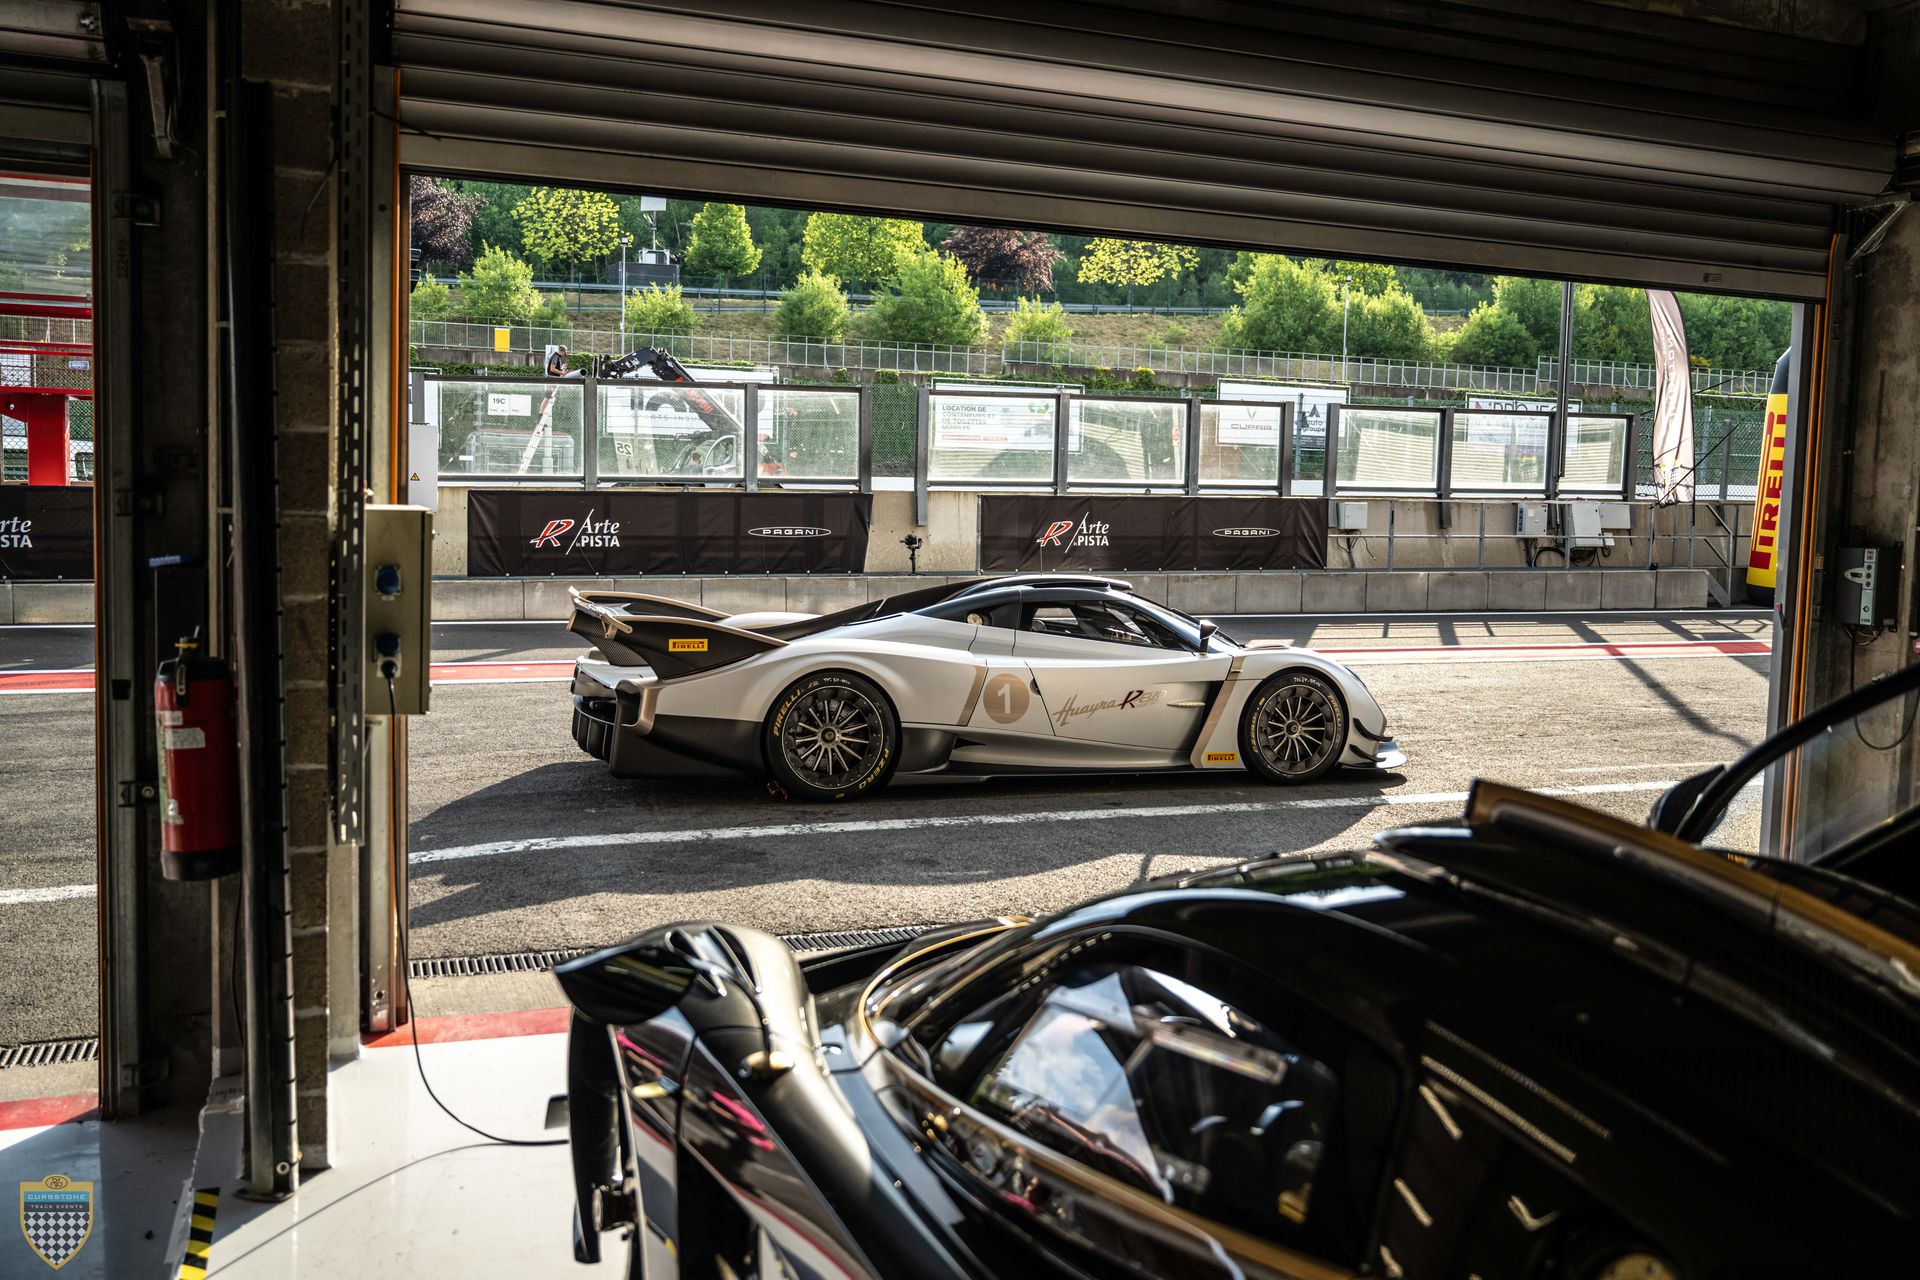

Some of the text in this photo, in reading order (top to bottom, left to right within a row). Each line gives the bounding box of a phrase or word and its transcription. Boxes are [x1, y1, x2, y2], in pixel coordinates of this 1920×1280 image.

[942, 405, 976, 413] LOCATION
[1231, 423, 1272, 431] CUPRA
[0, 516, 32, 533] rte
[581, 517, 620, 534] Arte
[1079, 518, 1110, 534] Arte
[0, 535, 33, 548] STA
[581, 536, 620, 547] PISTA
[1077, 536, 1109, 546] PISTA
[672, 641, 705, 649] PIRELLI
[997, 682, 1012, 715] 1
[773, 689, 801, 737] PIRELLI
[1050, 694, 1121, 727] Huayra
[1207, 753, 1235, 761] PIRELLI
